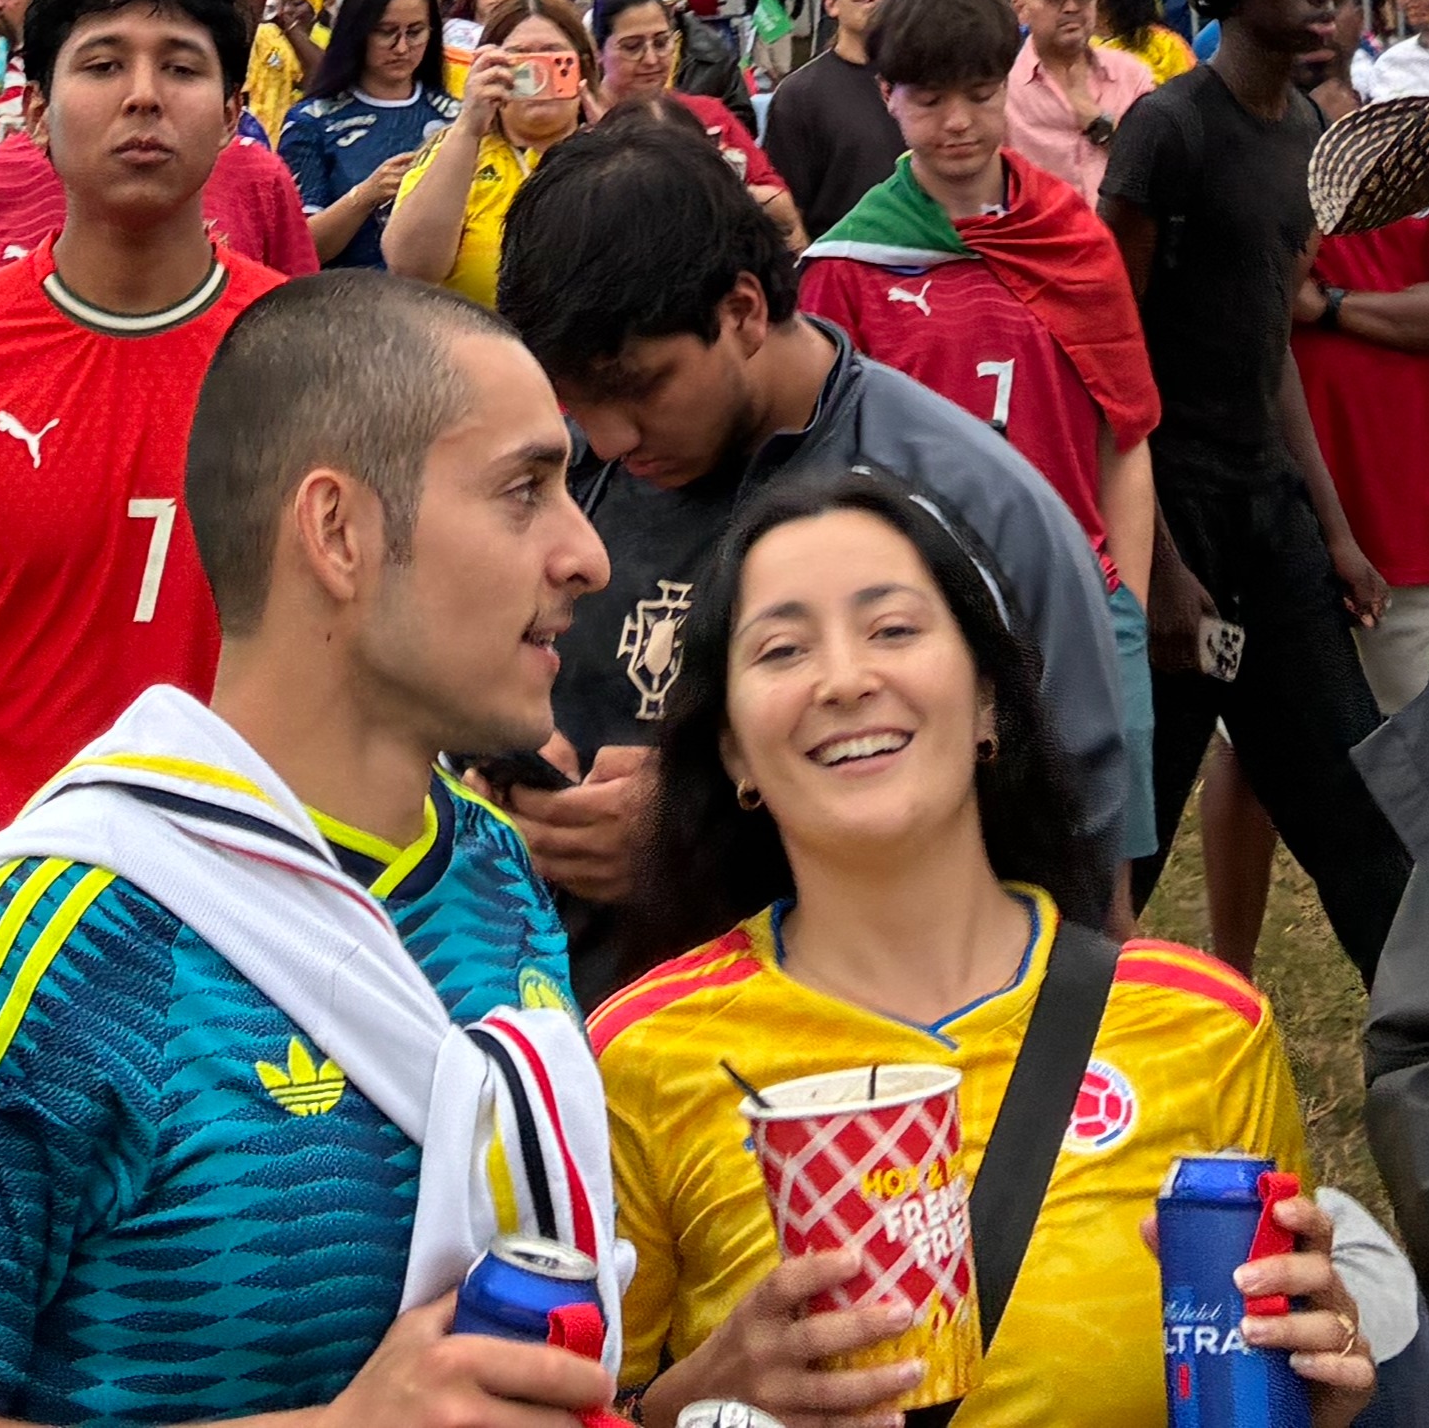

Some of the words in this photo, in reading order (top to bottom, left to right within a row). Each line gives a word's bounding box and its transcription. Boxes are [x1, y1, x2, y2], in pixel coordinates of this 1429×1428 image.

[976, 357, 1016, 427] 7
[127, 498, 177, 623] 7
[912, 1212, 969, 1269] FRIE
[1164, 1324, 1251, 1355] LTRA
